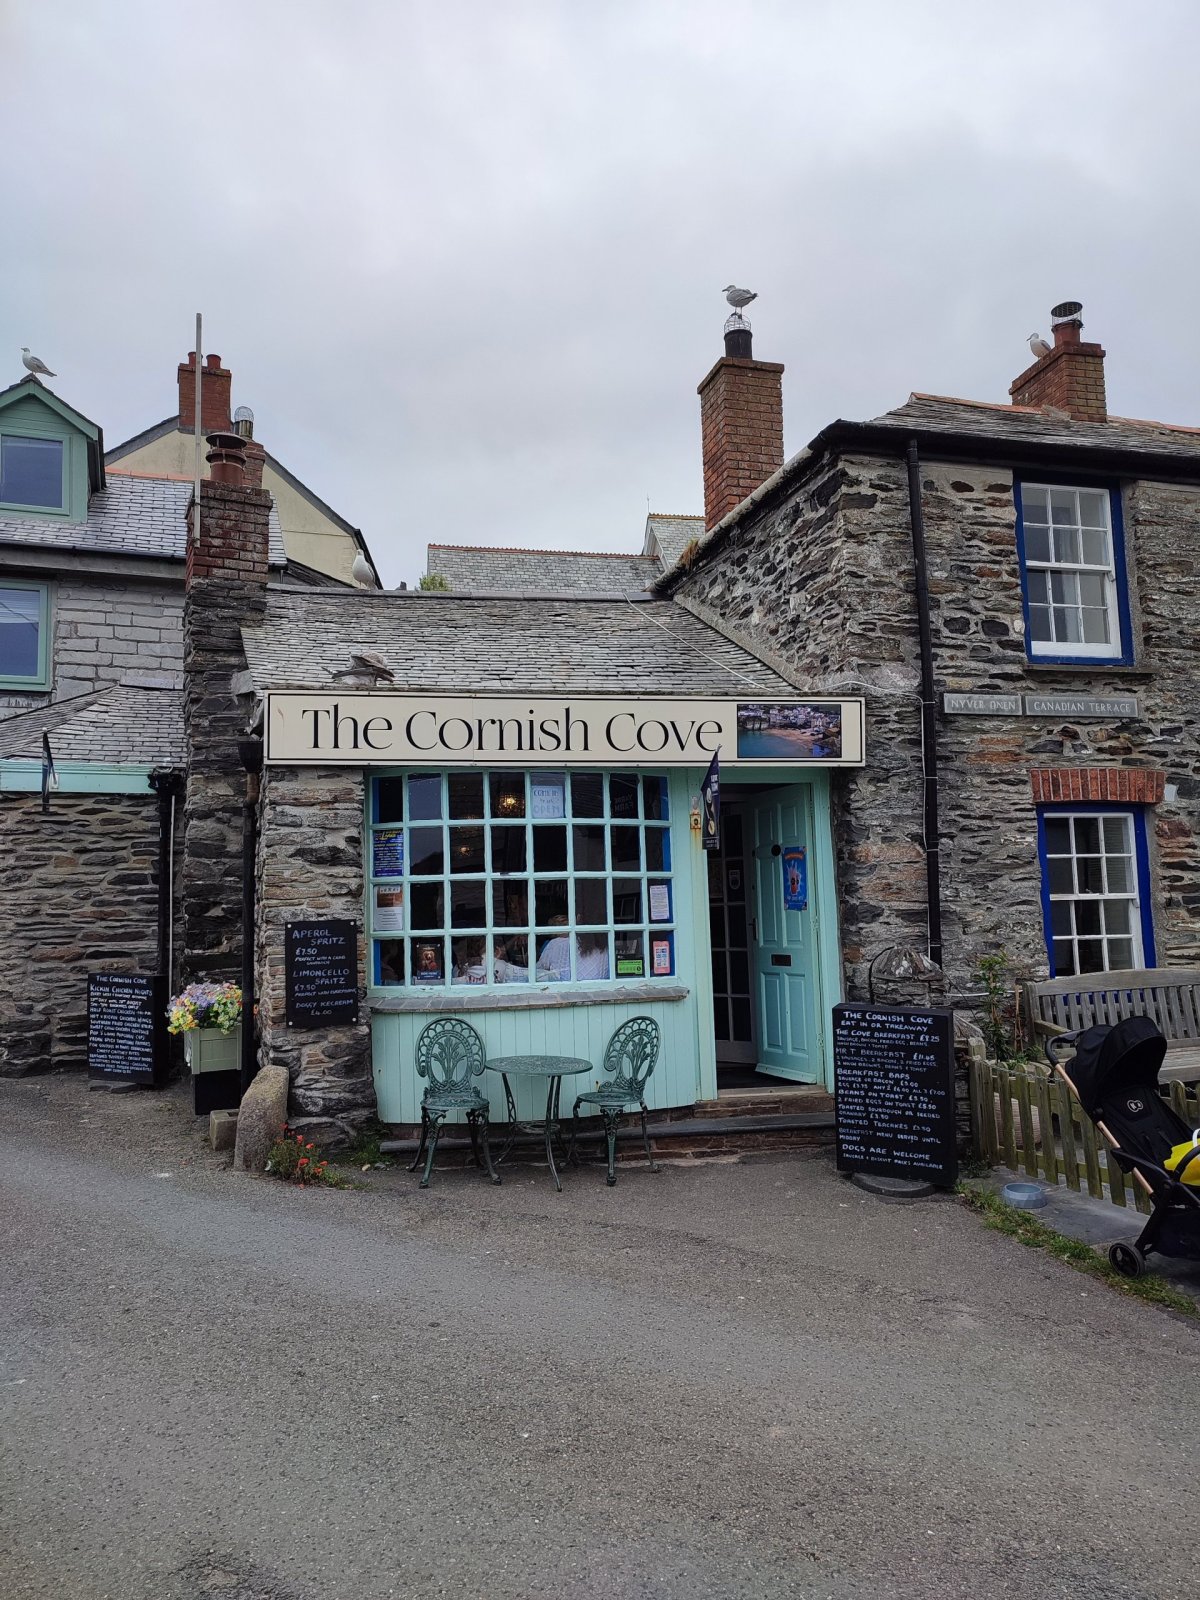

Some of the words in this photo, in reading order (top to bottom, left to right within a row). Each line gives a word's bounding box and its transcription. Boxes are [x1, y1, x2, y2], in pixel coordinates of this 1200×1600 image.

[951, 700, 985, 710] NYVER
[1034, 701, 1084, 712] CANADIAN
[1089, 702, 1131, 713] TERRACE
[302, 702, 393, 750] The
[405, 706, 592, 752] Cornish
[605, 712, 723, 752] Cove
[292, 930, 331, 939] APEROL
[310, 937, 346, 946] SPRITZ
[293, 969, 349, 977] LIMONCELLO
[112, 986, 133, 994] CHICKEN
[866, 1012, 904, 1022] CORNISH
[911, 1016, 933, 1024] COVE
[885, 1023, 928, 1032] TAKEAWAY
[861, 1050, 907, 1058] BREAKFAST
[837, 1068, 885, 1076] BREAKFAST
[873, 1121, 908, 1129] TEACAKES
[839, 1128, 874, 1136] BREAKFAST
[842, 1144, 866, 1152] DOGS
[893, 1150, 931, 1160] WELCOME
